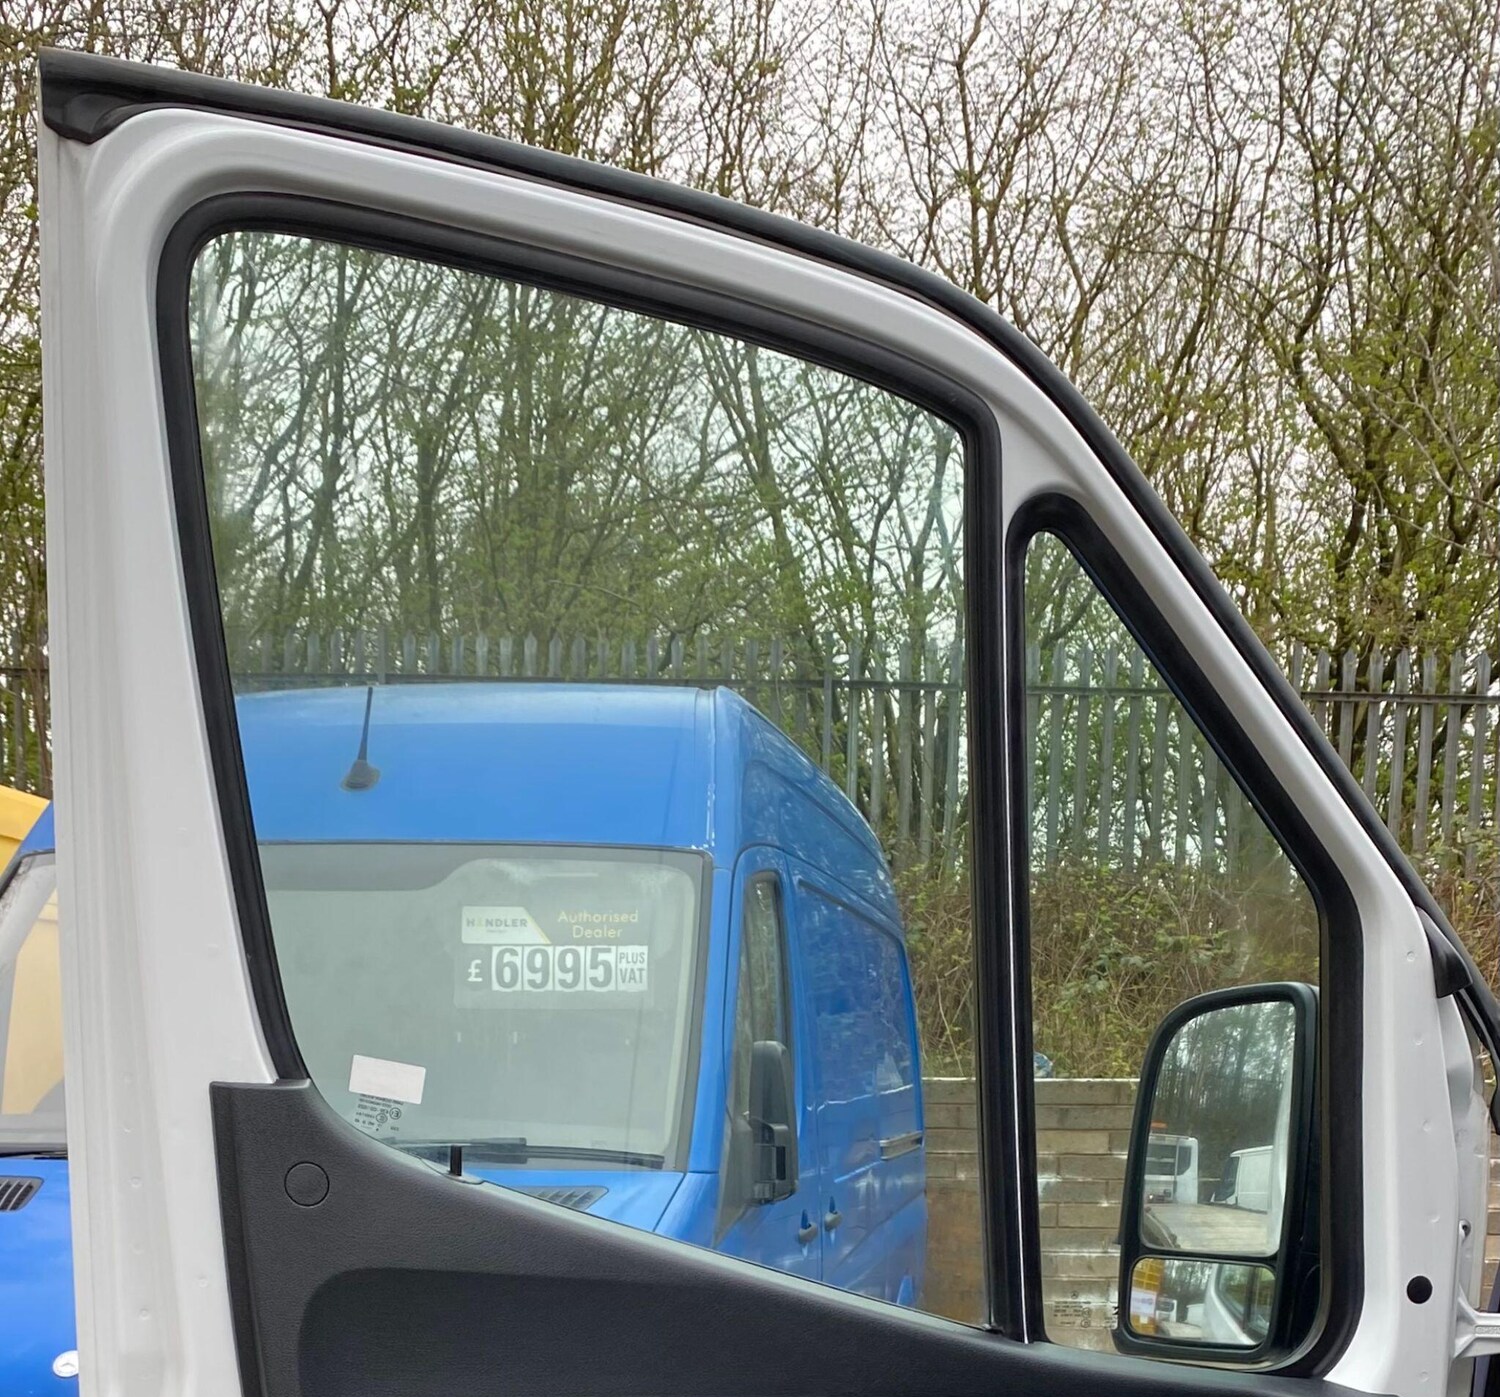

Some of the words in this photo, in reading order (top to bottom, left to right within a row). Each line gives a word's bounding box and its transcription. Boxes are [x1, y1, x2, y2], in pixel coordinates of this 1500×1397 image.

[558, 909, 638, 923] Authorised
[572, 925, 622, 938] Dealer
[619, 951, 645, 964] PLUS
[619, 968, 646, 984] VAT
